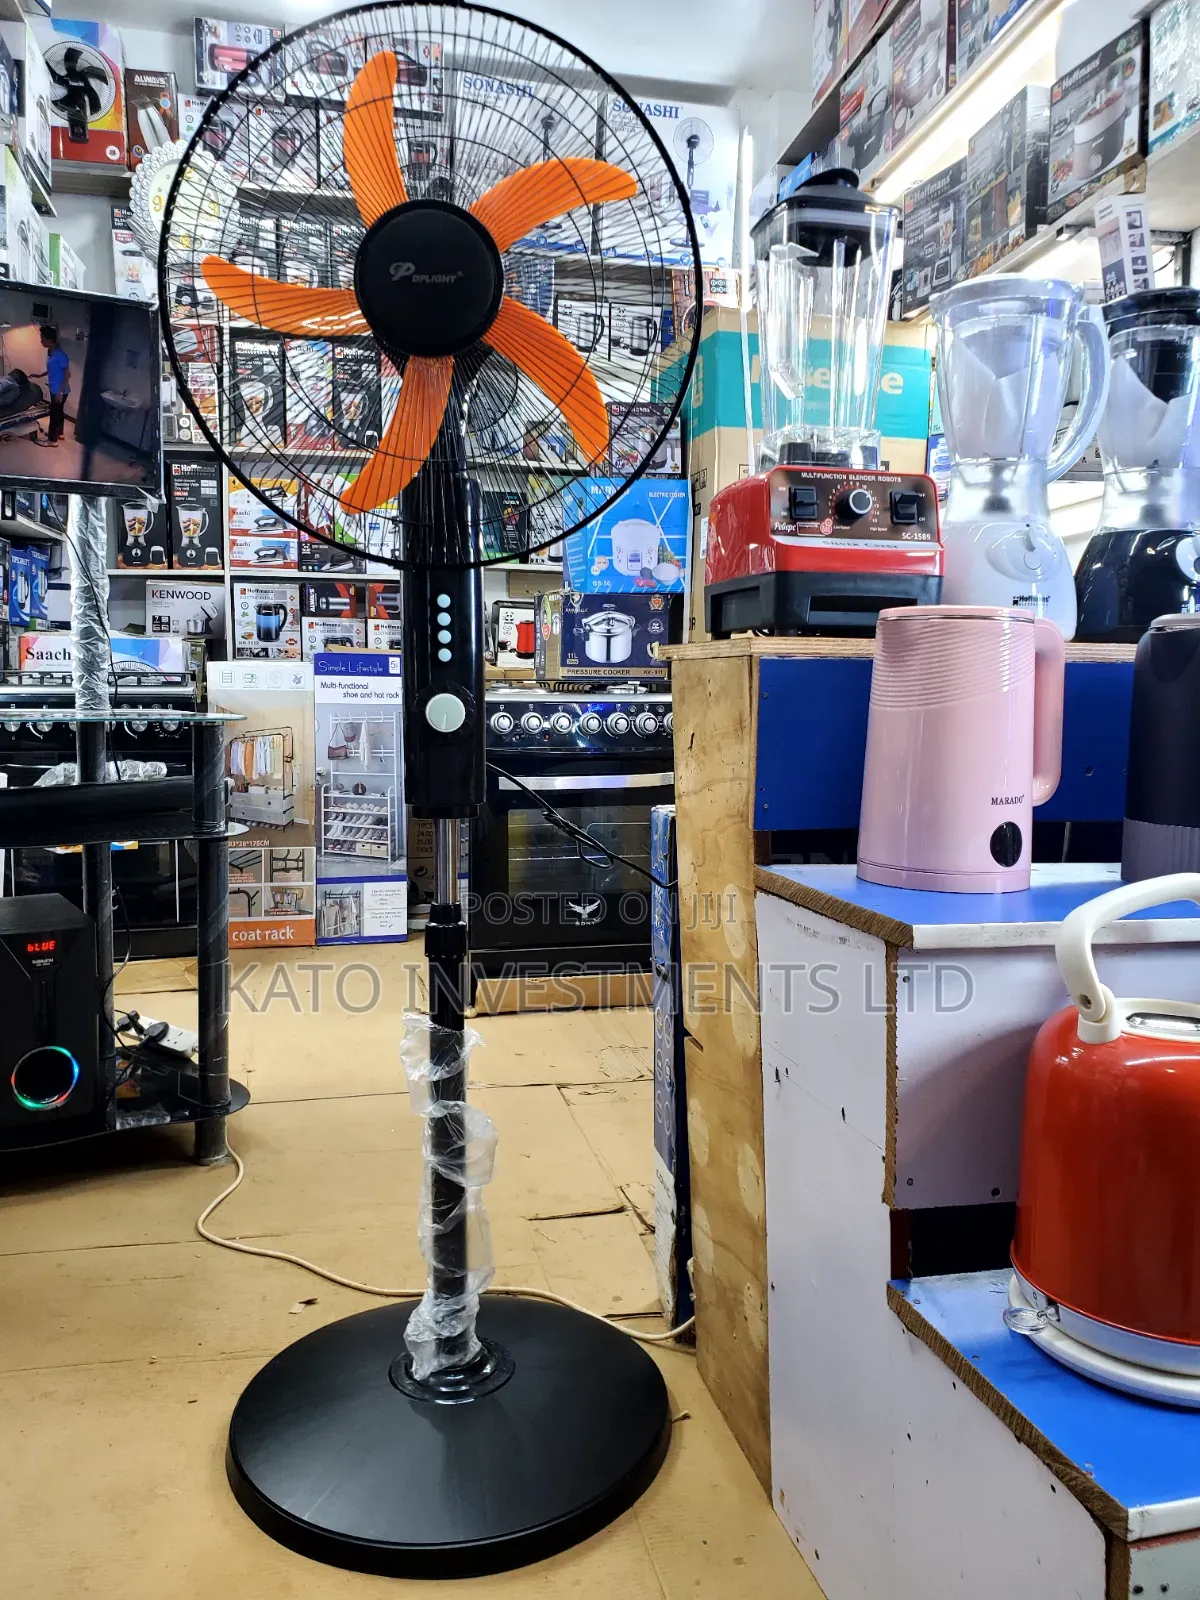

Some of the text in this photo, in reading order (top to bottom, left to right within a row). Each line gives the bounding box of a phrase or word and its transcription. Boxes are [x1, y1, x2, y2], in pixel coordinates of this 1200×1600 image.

[1062, 54, 1102, 87] Hoffmans
[134, 74, 166, 85] ALWAYS
[463, 76, 533, 98] SONASHI
[612, 99, 680, 119] SOASHI
[914, 169, 952, 201] Hoffmans
[801, 472, 847, 480] MULTIFUNCTION
[902, 532, 931, 541] SC-1589
[152, 590, 211, 600] KENWOOD
[25, 647, 72, 661] Saach
[318, 660, 383, 673] Simple Lifestyle
[320, 681, 368, 689] Multi-functional
[991, 795, 1024, 805] MARADO
[232, 926, 294, 941] coat rack
